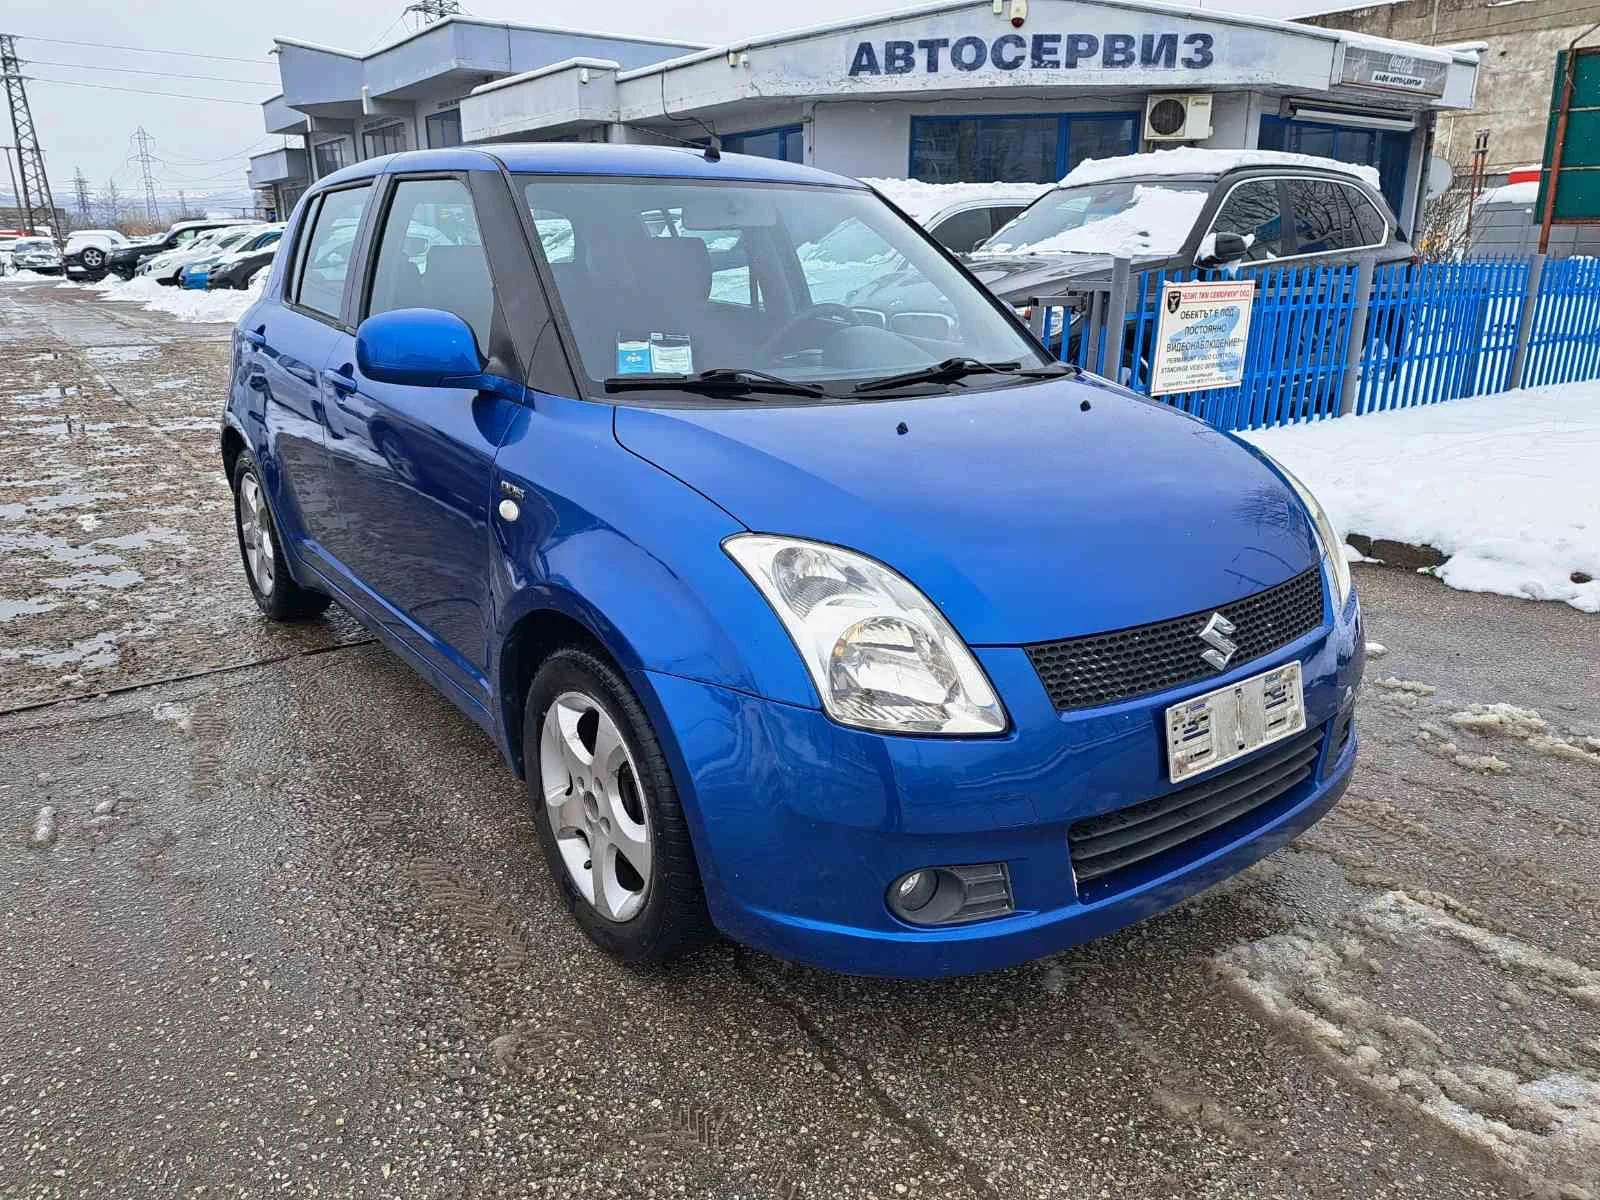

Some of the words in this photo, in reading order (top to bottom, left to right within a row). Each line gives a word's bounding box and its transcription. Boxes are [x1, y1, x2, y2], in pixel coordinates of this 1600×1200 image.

[849, 33, 1214, 76] АВТОСЕРВИЗ
[1180, 309, 1212, 320] ОБЕКТЪТ
[1220, 307, 1234, 317] ПОД
[1185, 324, 1226, 337] ПОСТОЯННО
